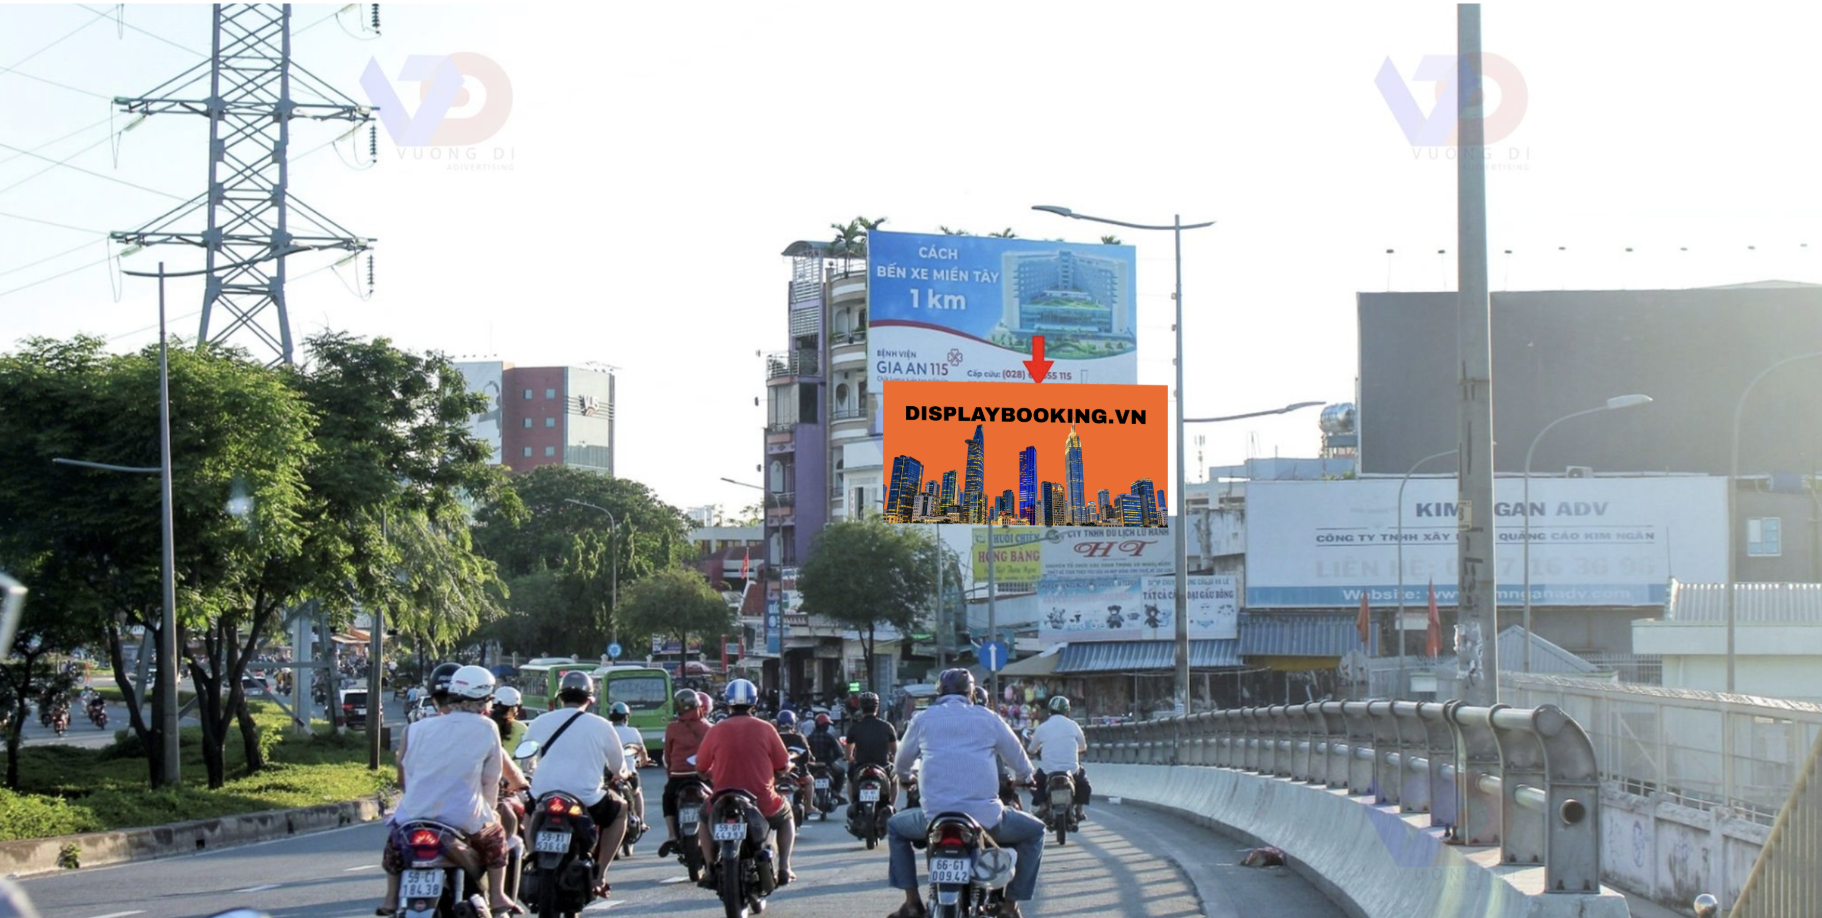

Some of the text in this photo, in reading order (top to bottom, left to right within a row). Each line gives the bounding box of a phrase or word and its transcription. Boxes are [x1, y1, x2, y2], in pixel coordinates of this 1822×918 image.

[918, 244, 958, 260] CÁCH
[876, 262, 907, 279] BẾN
[910, 267, 929, 280] XE
[973, 268, 999, 284] TÂY
[909, 288, 966, 310] 1 km
[876, 348, 917, 360] BỆNH VIỆN
[876, 360, 949, 376] GIA AN 115
[966, 369, 983, 378] Cấp
[1002, 369, 1026, 380] (028)
[1059, 371, 1072, 380] 115
[1416, 502, 1459, 517] KIM
[1555, 501, 1609, 517] ADV
[1316, 533, 1354, 543] CÔNG
[1358, 533, 1376, 542] TY
[1380, 533, 1418, 541] TNHH
[1423, 531, 1451, 541] XÂY
[1550, 530, 1579, 540] CÁO
[1584, 531, 1612, 540] KIM
[1315, 555, 1379, 578] LIÊN
[1342, 588, 1421, 601] Website:
[936, 859, 965, 871] 66-G1
[407, 870, 436, 883] 59-C1
[932, 871, 968, 882] 009.42
